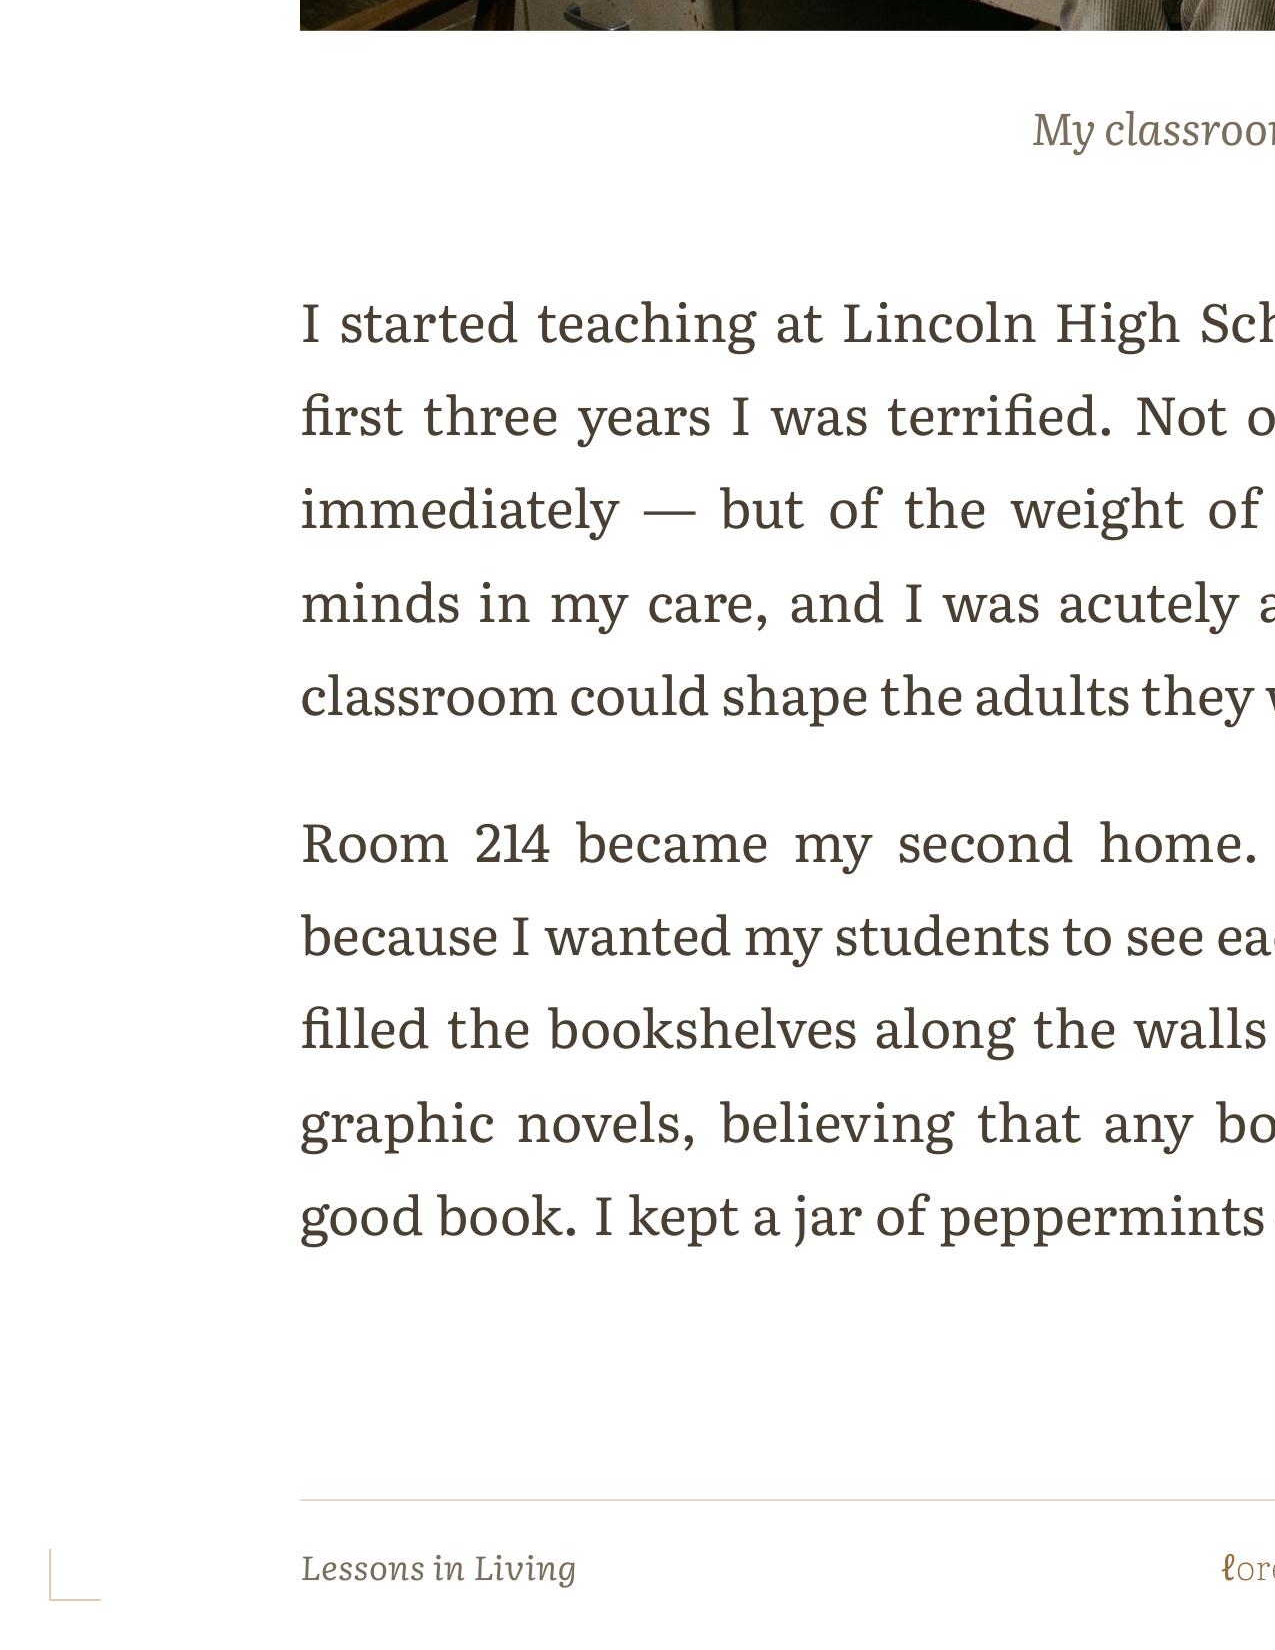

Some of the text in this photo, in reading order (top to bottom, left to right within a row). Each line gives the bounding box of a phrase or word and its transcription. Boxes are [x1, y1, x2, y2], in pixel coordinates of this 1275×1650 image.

[1032, 113, 1095, 156] My
[302, 303, 320, 343] I
[340, 300, 519, 344] started
[537, 300, 758, 356] teaching
[776, 305, 824, 344] at
[843, 300, 1037, 344] Lincoln
[1056, 300, 1181, 356] High
[301, 580, 460, 624] minds
[479, 581, 531, 623] in
[550, 593, 630, 636] my
[648, 593, 767, 632] care,
[791, 580, 885, 624] and
[905, 583, 923, 623] I
[941, 593, 1040, 624] was
[1059, 580, 1241, 636] acutely
[301, 673, 558, 717] classroom
[570, 673, 710, 717] could
[722, 673, 868, 728] shape
[880, 673, 963, 717] the
[975, 673, 1130, 717] adults
[1141, 673, 1256, 728] they
[302, 823, 449, 864] Room
[475, 823, 551, 863] 214
[575, 820, 768, 864] became
[794, 833, 874, 876] my
[898, 820, 1074, 864] second
[1099, 820, 1256, 864] home.
[300, 913, 498, 957] because
[512, 916, 530, 956] I
[543, 913, 732, 957] wanted
[744, 926, 824, 968] my
[835, 913, 1050, 957] students
[1062, 918, 1112, 957] to
[1126, 926, 1204, 957] see
[301, 1005, 430, 1050] filled
[447, 1006, 530, 1050] the
[547, 1006, 857, 1050] bookshelves
[875, 1006, 1017, 1062] along
[1033, 1006, 1116, 1050] the
[1132, 1006, 1267, 1050] walls
[300, 1193, 424, 1249] good
[436, 1193, 576, 1237] book.
[595, 1196, 613, 1236] I
[628, 1193, 740, 1248] kept
[753, 1206, 782, 1237] a
[794, 1194, 863, 1248] jar
[876, 1192, 931, 1237] of
[939, 1194, 1265, 1248] peppermints
[301, 1554, 576, 1589] Lessons in Living
